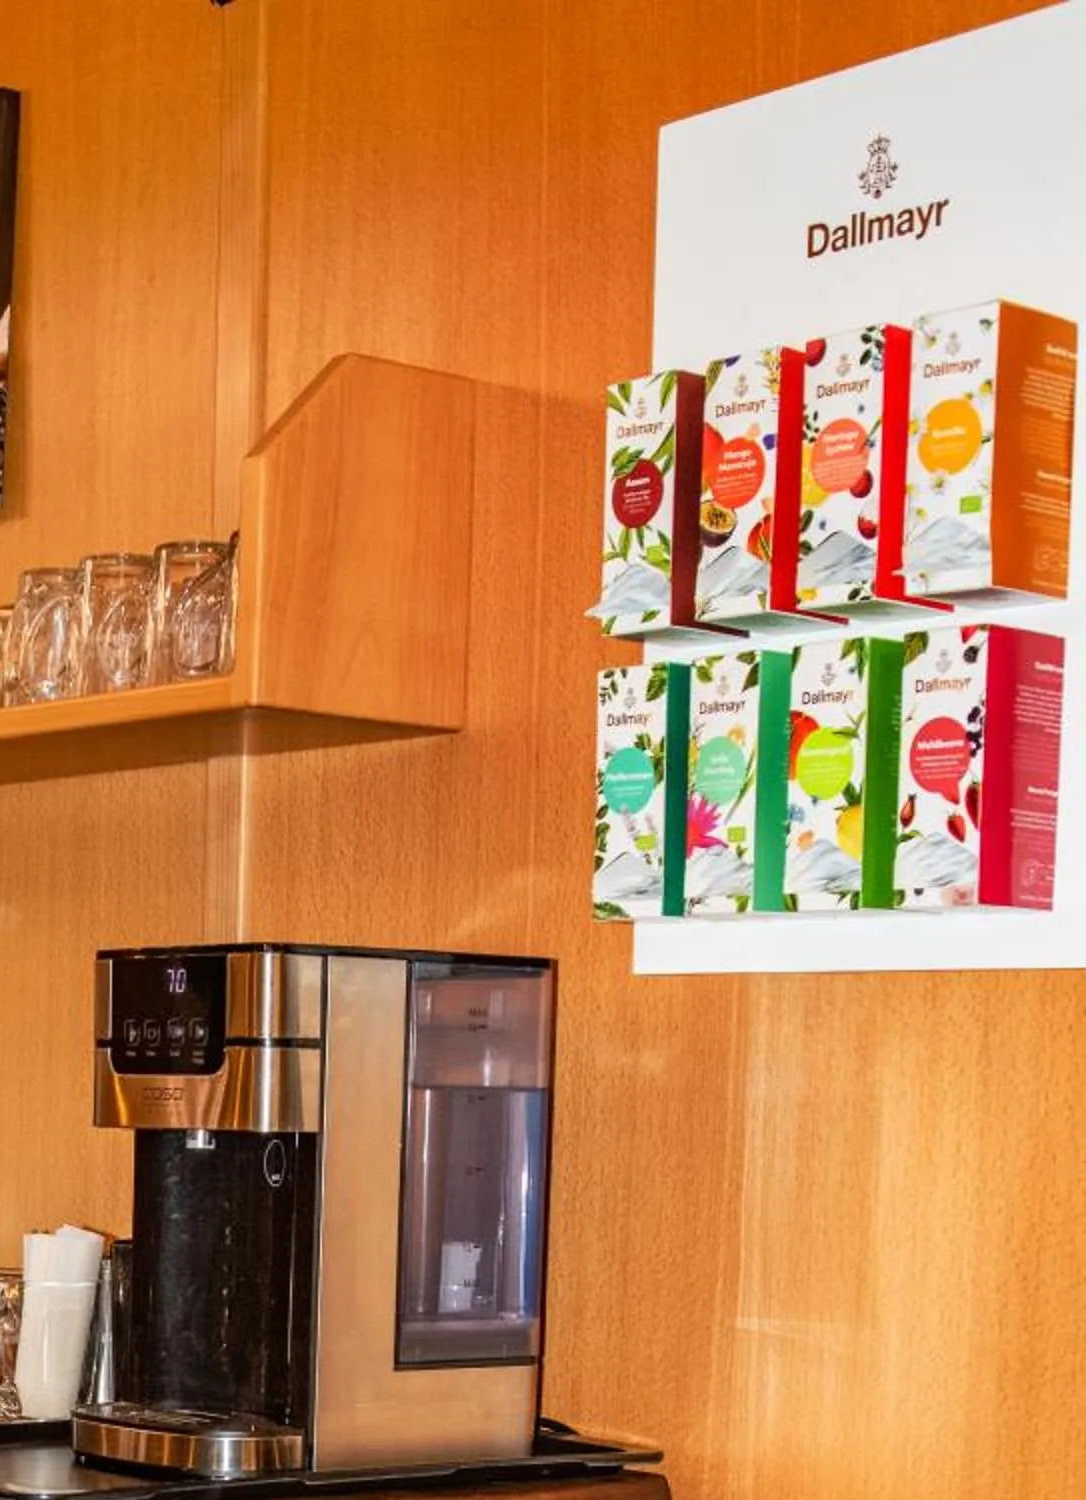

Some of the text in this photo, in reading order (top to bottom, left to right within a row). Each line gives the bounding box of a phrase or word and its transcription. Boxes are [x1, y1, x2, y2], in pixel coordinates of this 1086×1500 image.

[807, 197, 949, 258] Dallmayr
[923, 357, 981, 379] Dallmayr
[816, 377, 870, 399] Dallmayr
[715, 398, 766, 418] Dallmayr
[616, 420, 665, 439] Dallmayr
[915, 677, 970, 694] Dallmayr
[801, 689, 854, 705] Dallmayr
[699, 700, 746, 714] Dallmayr
[607, 712, 651, 727] Dallmayr
[166, 968, 187, 993] 70
